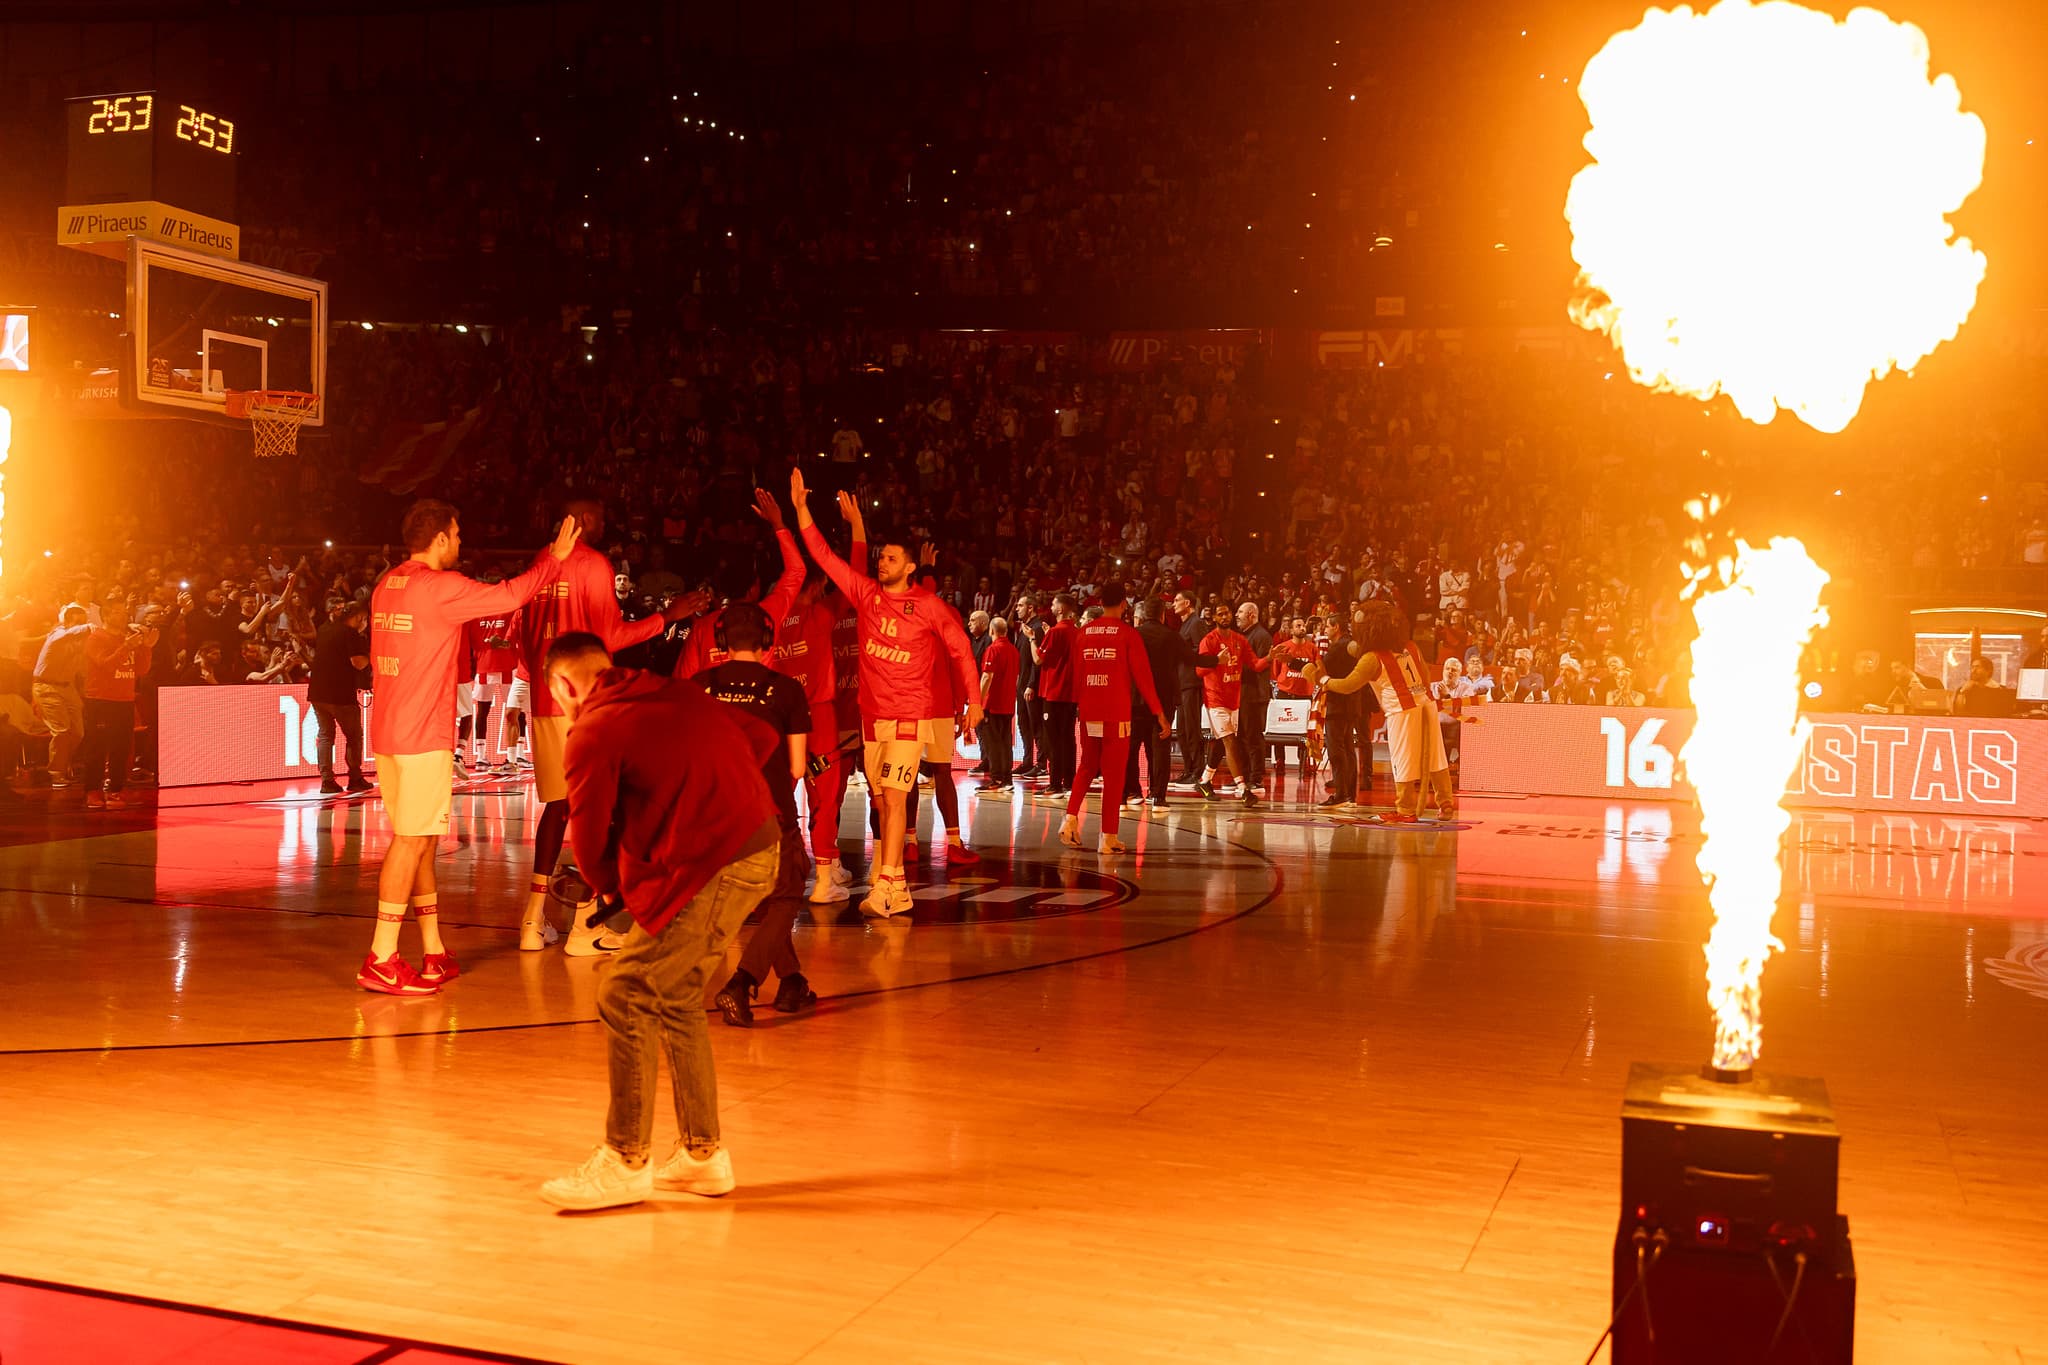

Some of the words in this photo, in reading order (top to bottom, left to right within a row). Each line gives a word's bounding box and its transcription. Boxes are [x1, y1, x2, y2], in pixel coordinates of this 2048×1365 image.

[88, 95, 153, 134] 2:53
[176, 104, 235, 154] 2:53
[87, 214, 148, 233] Piraeus
[178, 222, 233, 250] Piraeus
[373, 611, 414, 632] FMS
[880, 617, 897, 637] 16
[865, 638, 911, 664] bwin
[1083, 647, 1117, 659] FMS
[1600, 717, 1674, 788] 16
[897, 765, 913, 784] 16
